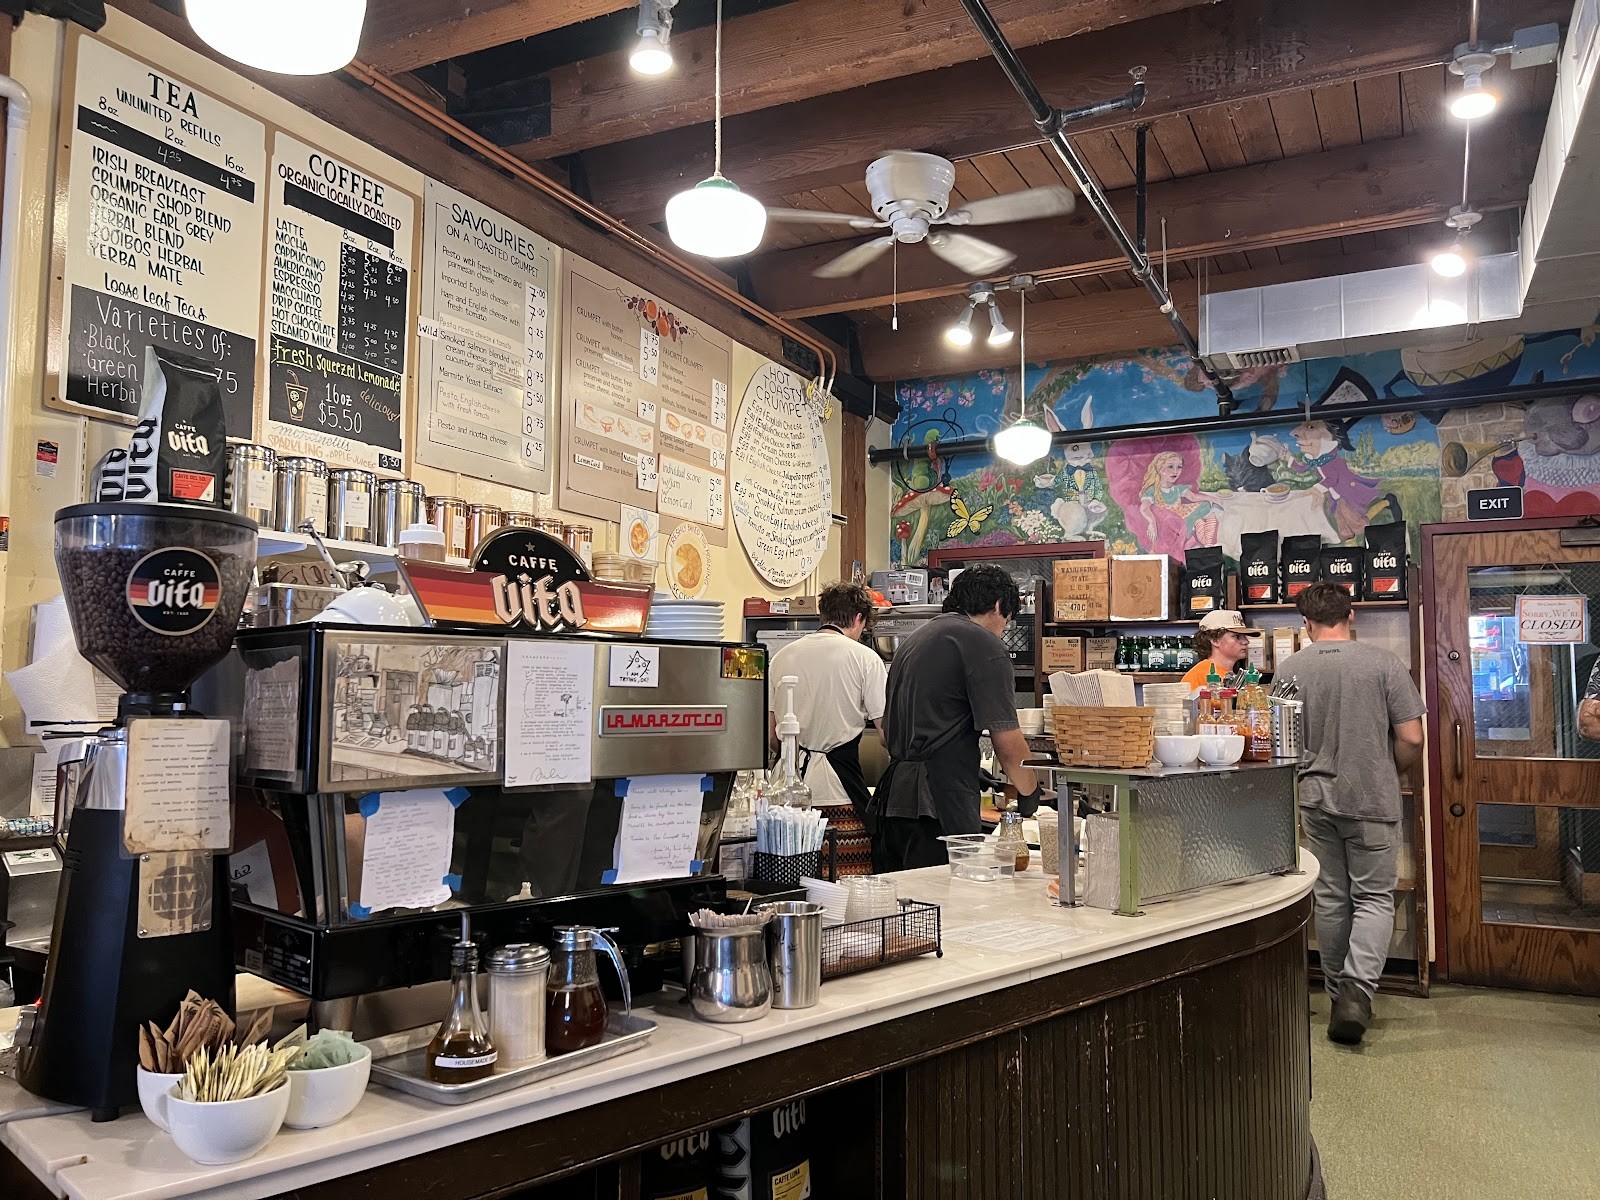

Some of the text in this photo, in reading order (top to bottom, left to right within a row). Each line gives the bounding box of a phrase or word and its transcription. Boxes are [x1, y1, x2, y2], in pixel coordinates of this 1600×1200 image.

[148, 72, 200, 119] TEA
[116, 87, 221, 147] UNLIMITED REFILLS
[92, 145, 206, 204] IRISH BREAKFAST
[309, 154, 385, 208] COFFEE
[91, 166, 232, 234] CRUMPET SHOP BLEND
[278, 163, 402, 231] ORGANIC LOCALLY ROASTED
[90, 184, 214, 243] ORGANIC EARL GREY
[145, 222, 185, 249] BLEND
[275, 217, 304, 239] LATTE
[275, 229, 308, 252] MOCHA
[451, 203, 535, 261] SAVOURIES
[89, 222, 205, 275] ROOIBOS HERBAL
[274, 243, 326, 272] CAPPUCCINO
[446, 225, 539, 279] ON A TOASTED CRUMPET
[89, 241, 183, 286] YERBA MATE
[274, 255, 323, 283] AMERICANO
[442, 245, 523, 289] Pesto with fresh tomato and
[447, 260, 495, 285] parmesan cheese
[272, 281, 323, 308] MACCHIATO
[273, 268, 321, 295] ESPRESSO
[441, 272, 468, 289] Imported
[469, 282, 489, 298] English
[489, 293, 509, 306] cheese
[104, 272, 208, 321] Loose Leaf Teas
[272, 293, 323, 321] DRIP COFFEE
[440, 288, 521, 328] Ham and English cheese with
[272, 306, 336, 339] HOT CHOCOLATE
[447, 300, 488, 322] fresh tomato
[576, 306, 601, 324] CRUMPET
[87, 323, 137, 358] Black
[96, 296, 233, 361] Varieties of:
[271, 319, 332, 349] STEAMED MILK
[418, 323, 438, 338] Wild
[576, 332, 601, 349] CRUMPET
[440, 331, 522, 368] Smoked salmon blended with
[445, 344, 507, 371] cream served
[662, 347, 704, 372] FAVORITE CRUMPETS
[87, 350, 138, 381] Green
[275, 339, 400, 393] Fresh Squeezed Lemonade
[445, 354, 492, 374] cucumber slices
[575, 358, 601, 375] CRUMPET
[769, 366, 790, 387] HOT
[439, 366, 464, 382] Marmite
[465, 374, 482, 388] Yeast
[483, 381, 503, 395] Extract
[763, 373, 802, 402] TOASTY
[360, 388, 401, 423] delicious!
[456, 403, 472, 416] fresh
[460, 394, 482, 408] English
[752, 399, 803, 430] Egg English Cheese
[755, 385, 813, 418] CRUMPET
[174, 423, 197, 433] CAFFE
[318, 399, 362, 434] $5.50
[437, 418, 509, 446] Pesto and ricotta cheese
[574, 436, 599, 451] CRUMPET
[267, 434, 323, 458] SPARKLING
[662, 462, 702, 484] Individual scone
[735, 481, 747, 498] Egg
[755, 492, 776, 511] Smoked
[776, 503, 794, 516] Salmon
[1479, 497, 1511, 511] EXIT
[745, 516, 765, 536] Tomato
[754, 505, 770, 523] Green
[770, 513, 780, 530] Egg
[783, 518, 802, 532] English
[801, 517, 819, 530] cheese
[756, 536, 804, 560] Green Egg Ham
[163, 568, 196, 578] CAFFE
[508, 554, 559, 573] CAFFE
[1060, 566, 1098, 574] WASHINGTON
[1247, 564, 1270, 578] Vita
[1288, 562, 1312, 575] Vita
[1330, 561, 1354, 575] Vita
[1372, 555, 1398, 569] Vita
[147, 579, 205, 610] Vita
[490, 572, 589, 629] Vita
[1069, 603, 1086, 612] 470 C
[1520, 619, 1582, 630] CLOSED
[607, 713, 723, 728] LA MARZOCCO
[774, 1167, 801, 1186] CAFFE LUNA
